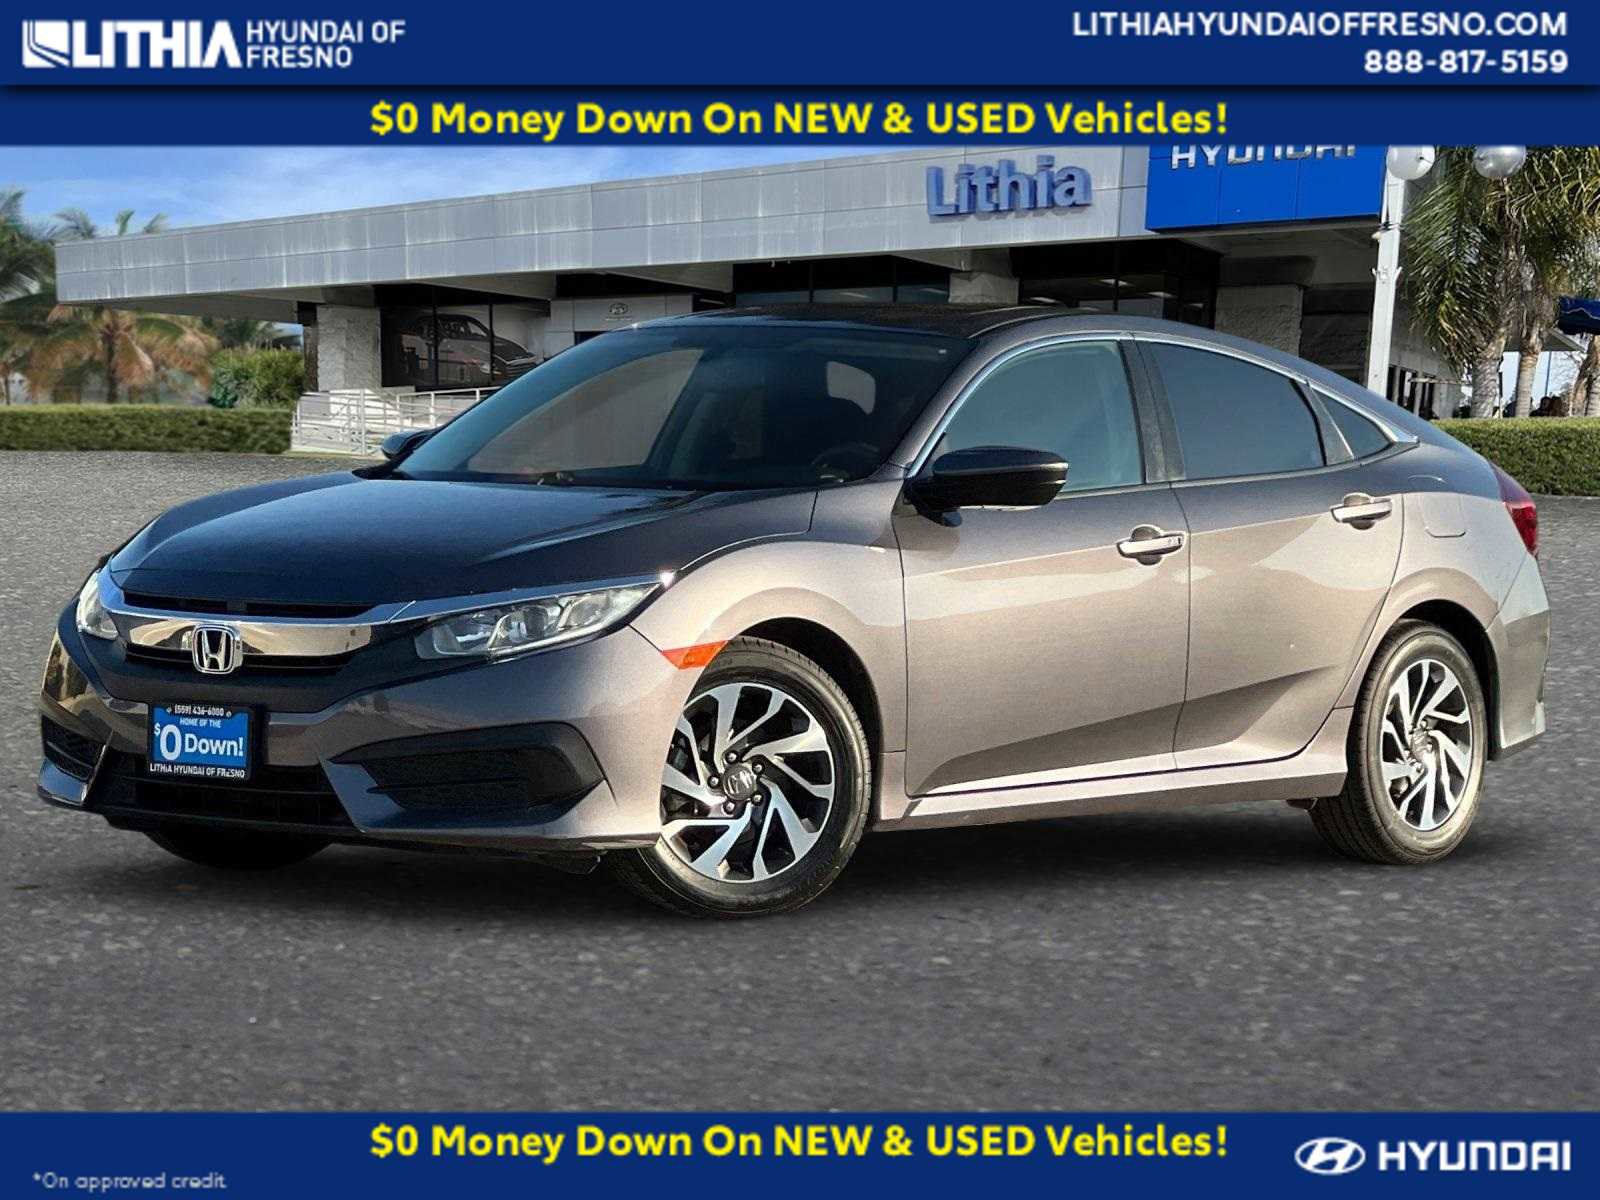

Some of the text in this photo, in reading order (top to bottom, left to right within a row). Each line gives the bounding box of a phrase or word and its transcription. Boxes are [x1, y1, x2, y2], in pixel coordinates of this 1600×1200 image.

[926, 154, 1093, 216] Lithia
[179, 718, 222, 728] HOME OF THE
[184, 733, 244, 757] Down!
[150, 763, 245, 778] LITHIA HYUNDAI OF FRESNO
